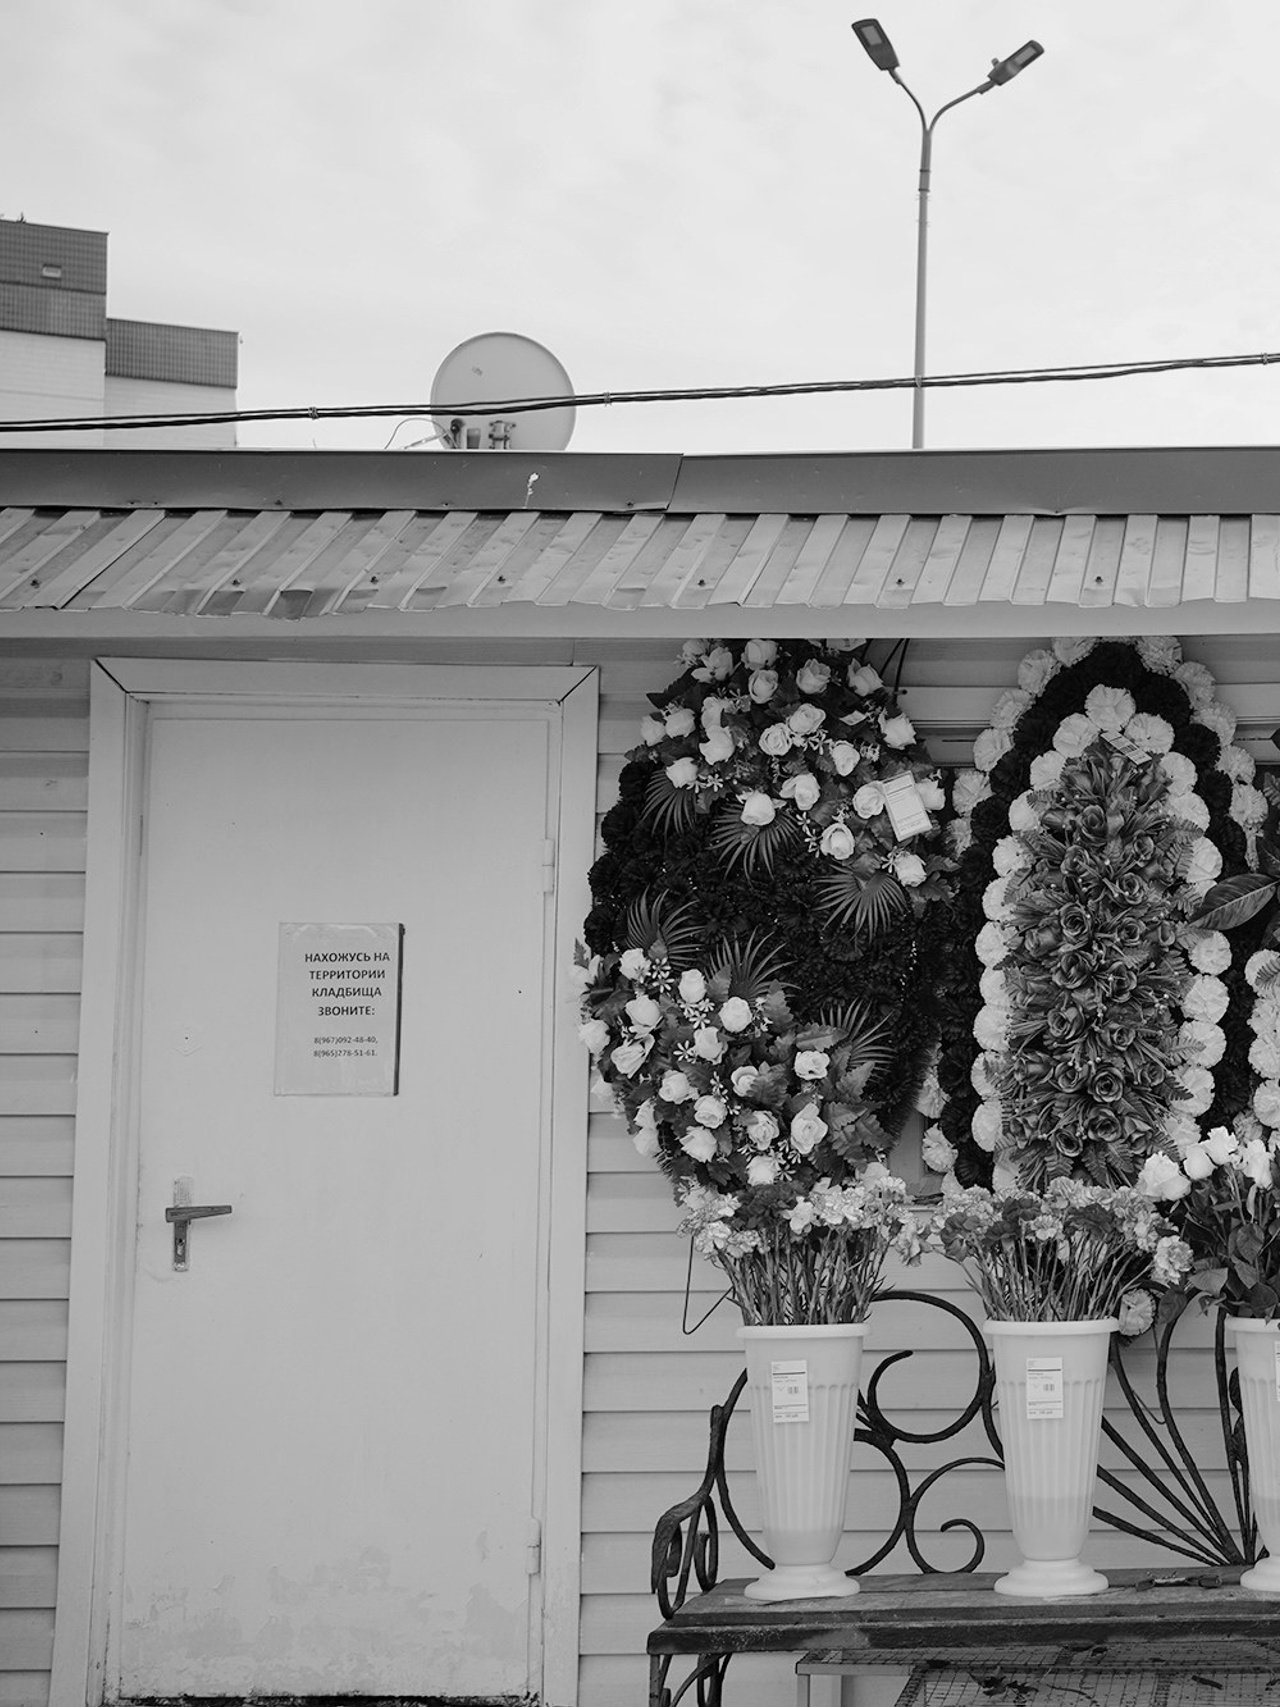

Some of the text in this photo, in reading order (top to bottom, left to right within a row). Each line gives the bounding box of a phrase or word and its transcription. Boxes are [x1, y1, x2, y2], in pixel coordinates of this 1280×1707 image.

[305, 952, 390, 963] НАХОЖУСЬ НА
[309, 969, 385, 980] ТЕРРИТОРИИ
[312, 987, 382, 999] КЛАДБИЩА
[318, 1006, 376, 1016] ЗВОНИТЕ:
